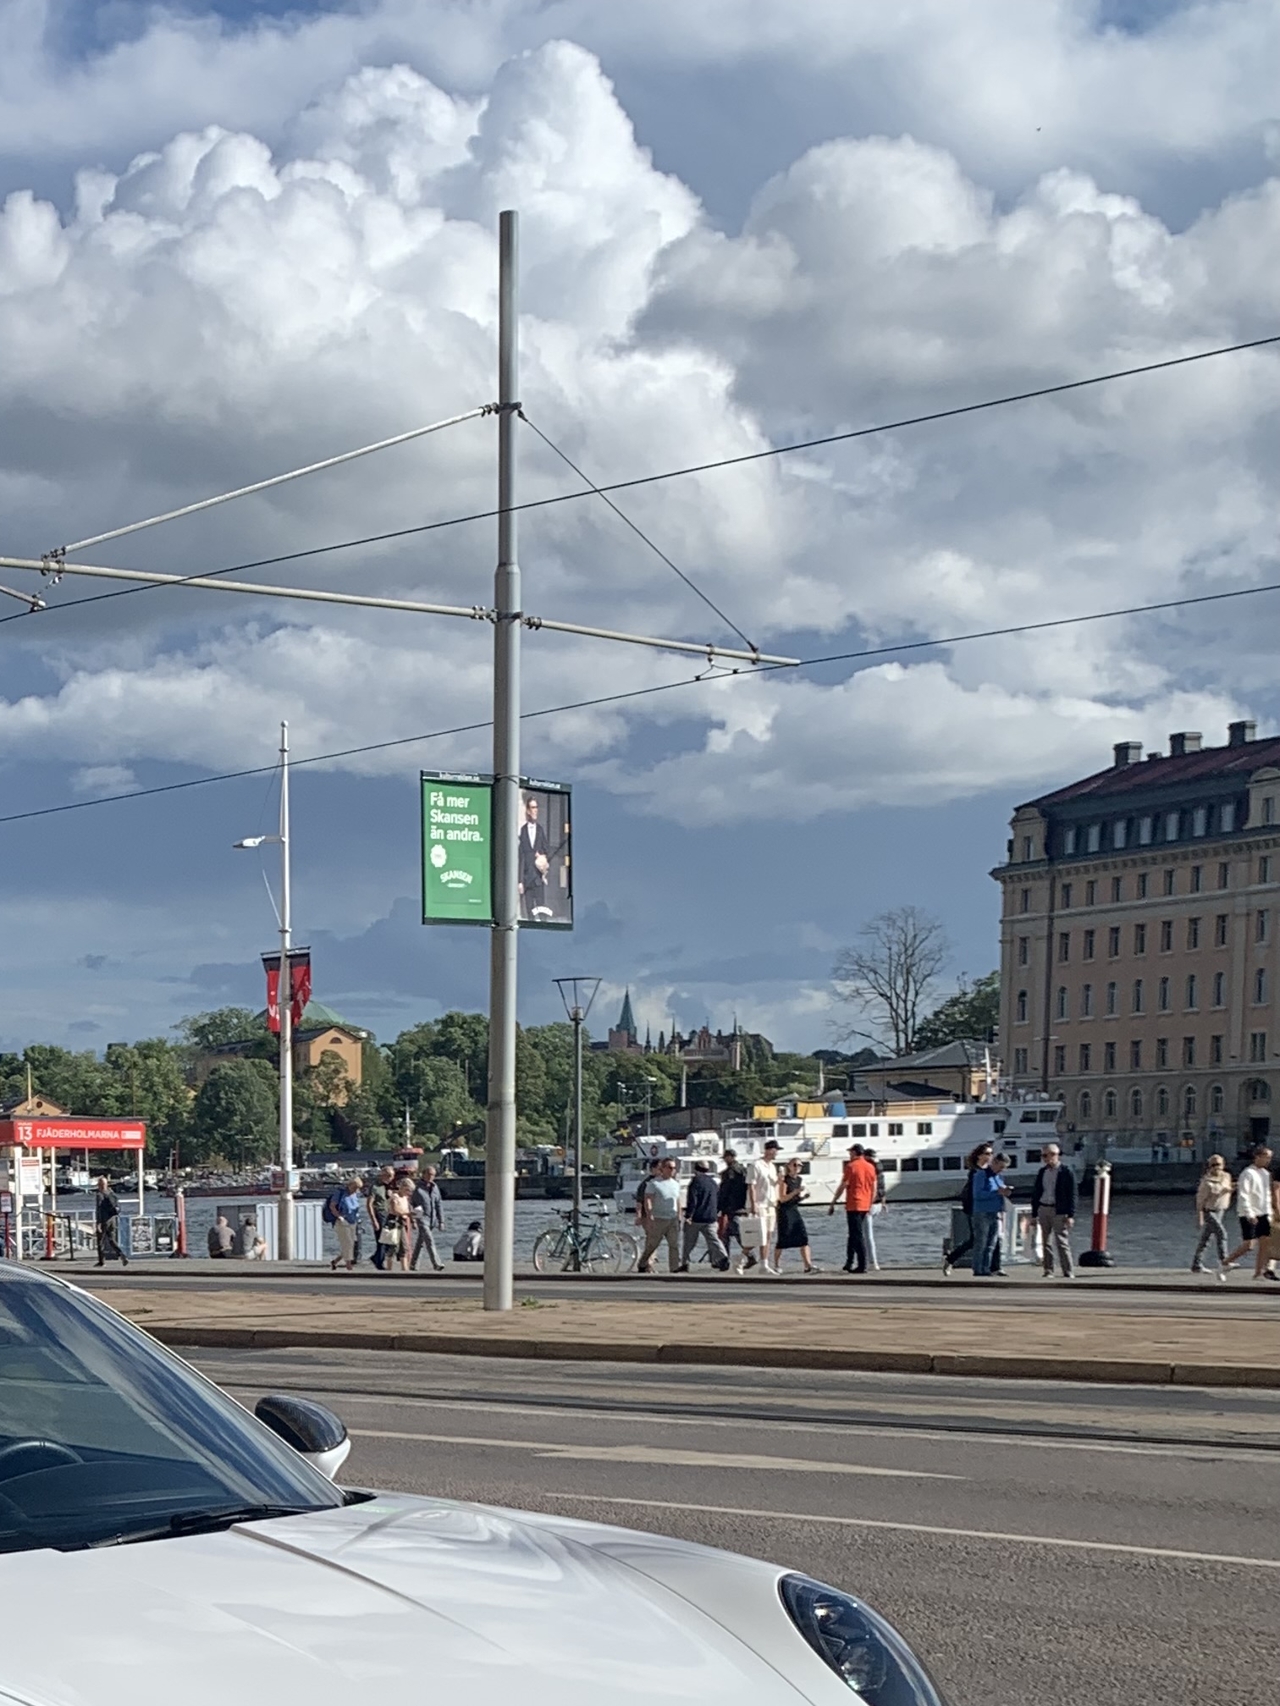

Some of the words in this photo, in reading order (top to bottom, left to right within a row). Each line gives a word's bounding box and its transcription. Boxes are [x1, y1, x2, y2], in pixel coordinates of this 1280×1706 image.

[430, 791, 444, 806] Få
[446, 796, 470, 808] mer
[430, 809, 479, 825] Skansen
[430, 825, 444, 840] än
[446, 828, 484, 842] andra.
[440, 870, 473, 884] SKANSEN
[18, 1127, 33, 1141] 13
[36, 1126, 120, 1140] FJÄDERHOLMARNA
